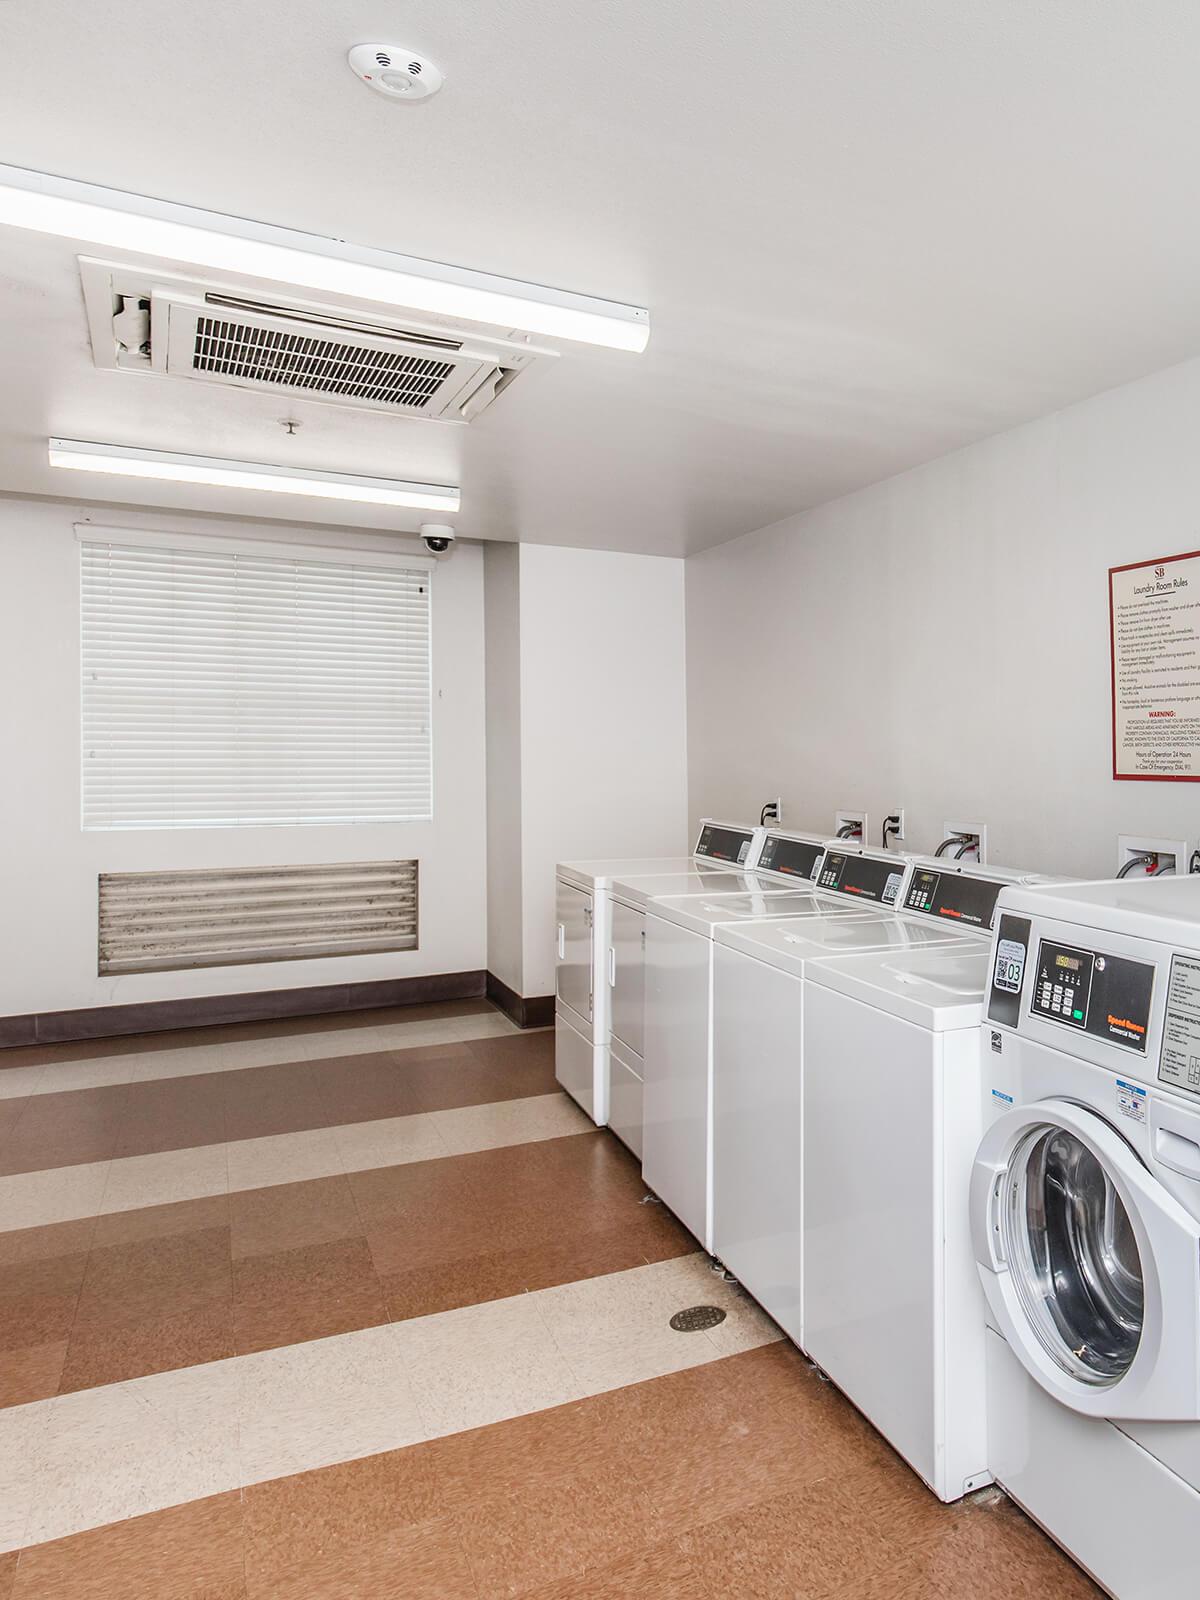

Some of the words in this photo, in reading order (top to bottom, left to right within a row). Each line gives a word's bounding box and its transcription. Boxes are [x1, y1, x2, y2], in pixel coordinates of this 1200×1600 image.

[1154, 567, 1165, 578] SB
[1134, 584, 1155, 594] Laundry
[1156, 582, 1172, 590] Room
[1173, 578, 1188, 587] Rules
[1008, 964, 1020, 981] 03
